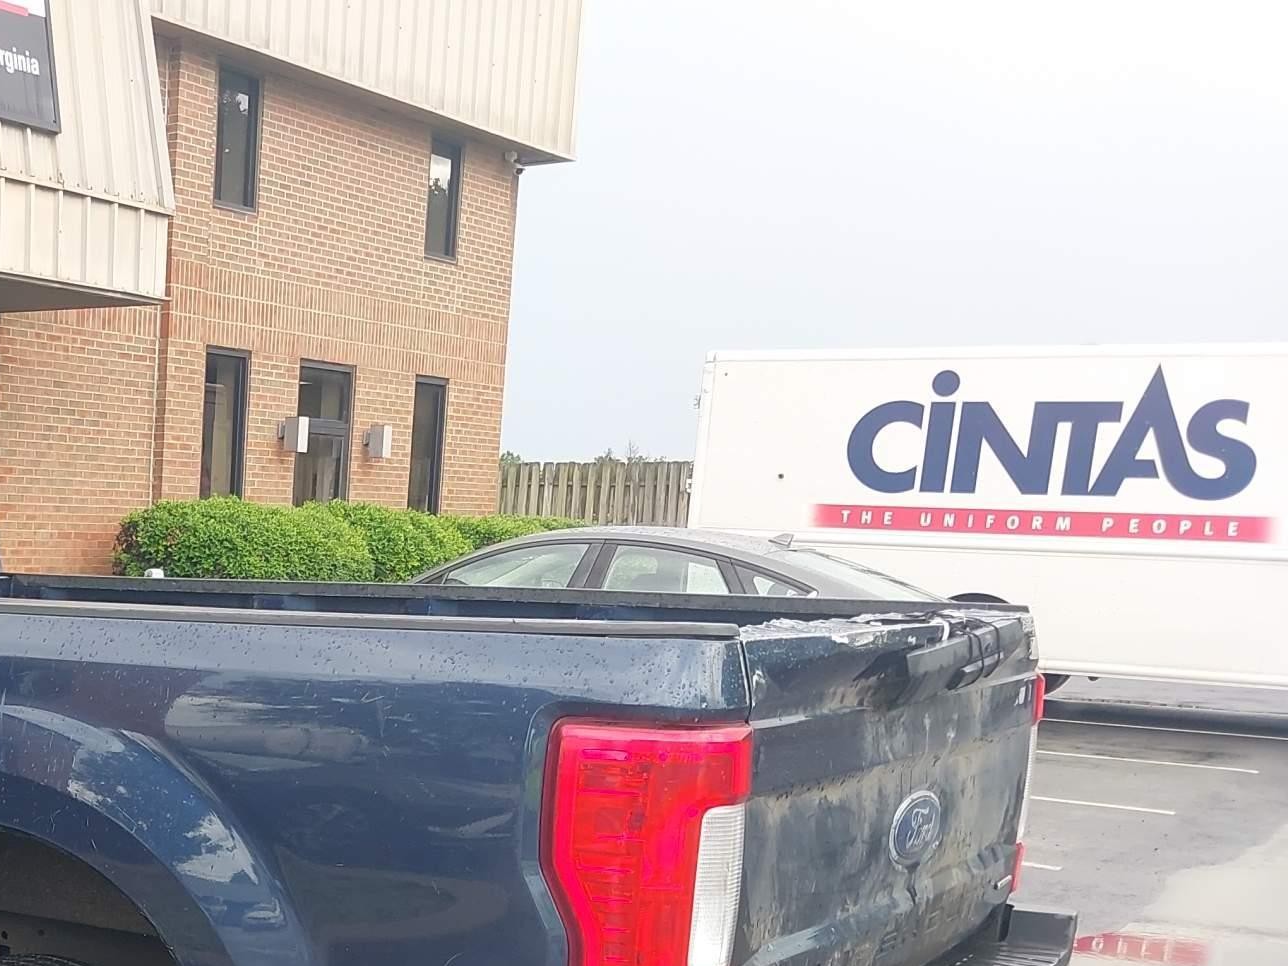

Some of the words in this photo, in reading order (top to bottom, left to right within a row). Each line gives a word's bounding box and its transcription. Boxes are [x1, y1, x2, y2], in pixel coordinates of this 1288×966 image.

[841, 510, 894, 525] THE
[919, 512, 1072, 531] UNIFORM
[1101, 517, 1240, 537] PEOPLE
[905, 806, 936, 849] Ford
